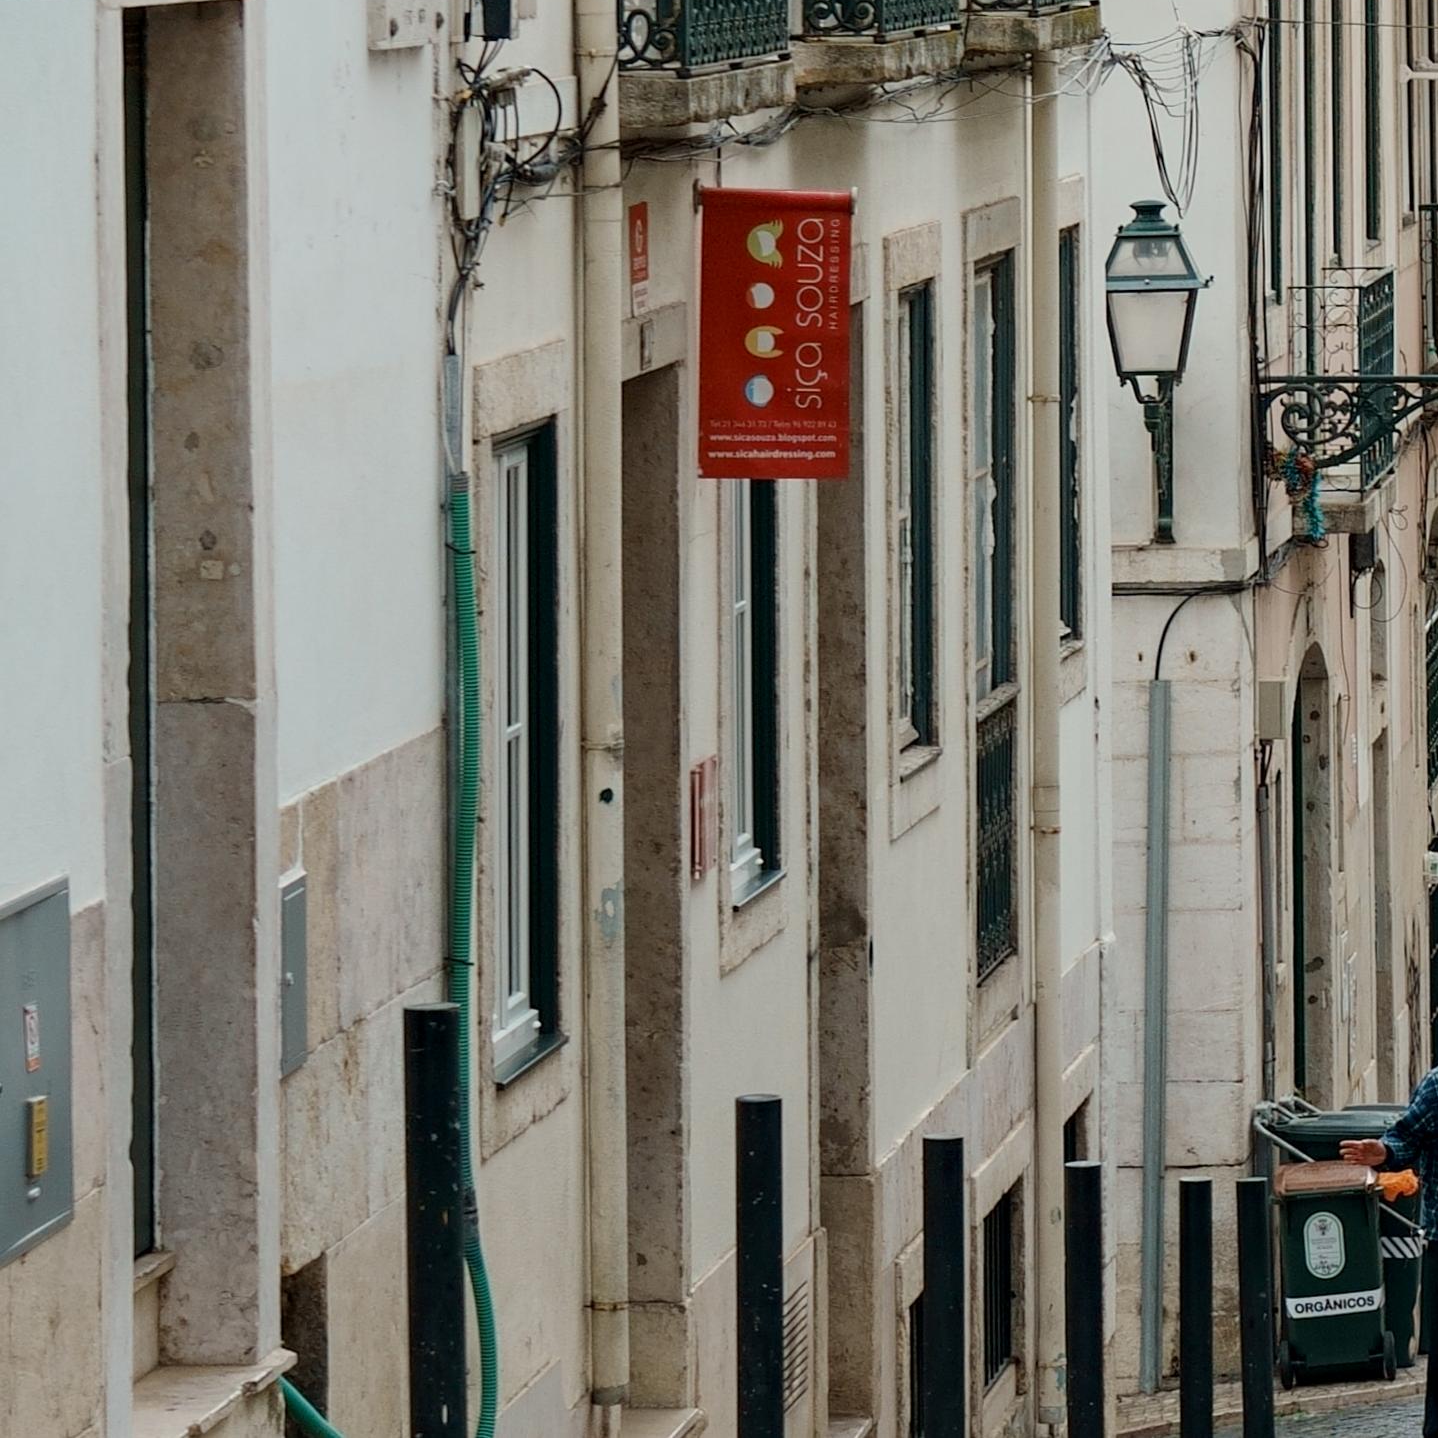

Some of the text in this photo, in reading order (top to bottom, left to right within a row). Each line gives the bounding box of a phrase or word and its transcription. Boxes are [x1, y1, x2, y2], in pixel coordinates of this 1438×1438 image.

[828, 218, 841, 331] HAIRDRESSING
[709, 433, 837, 443] www.sicasouza.blogspot.com
[708, 450, 836, 460] www.sicahairdressing.com
[1295, 1296, 1375, 1314] ORGÂNICOS
